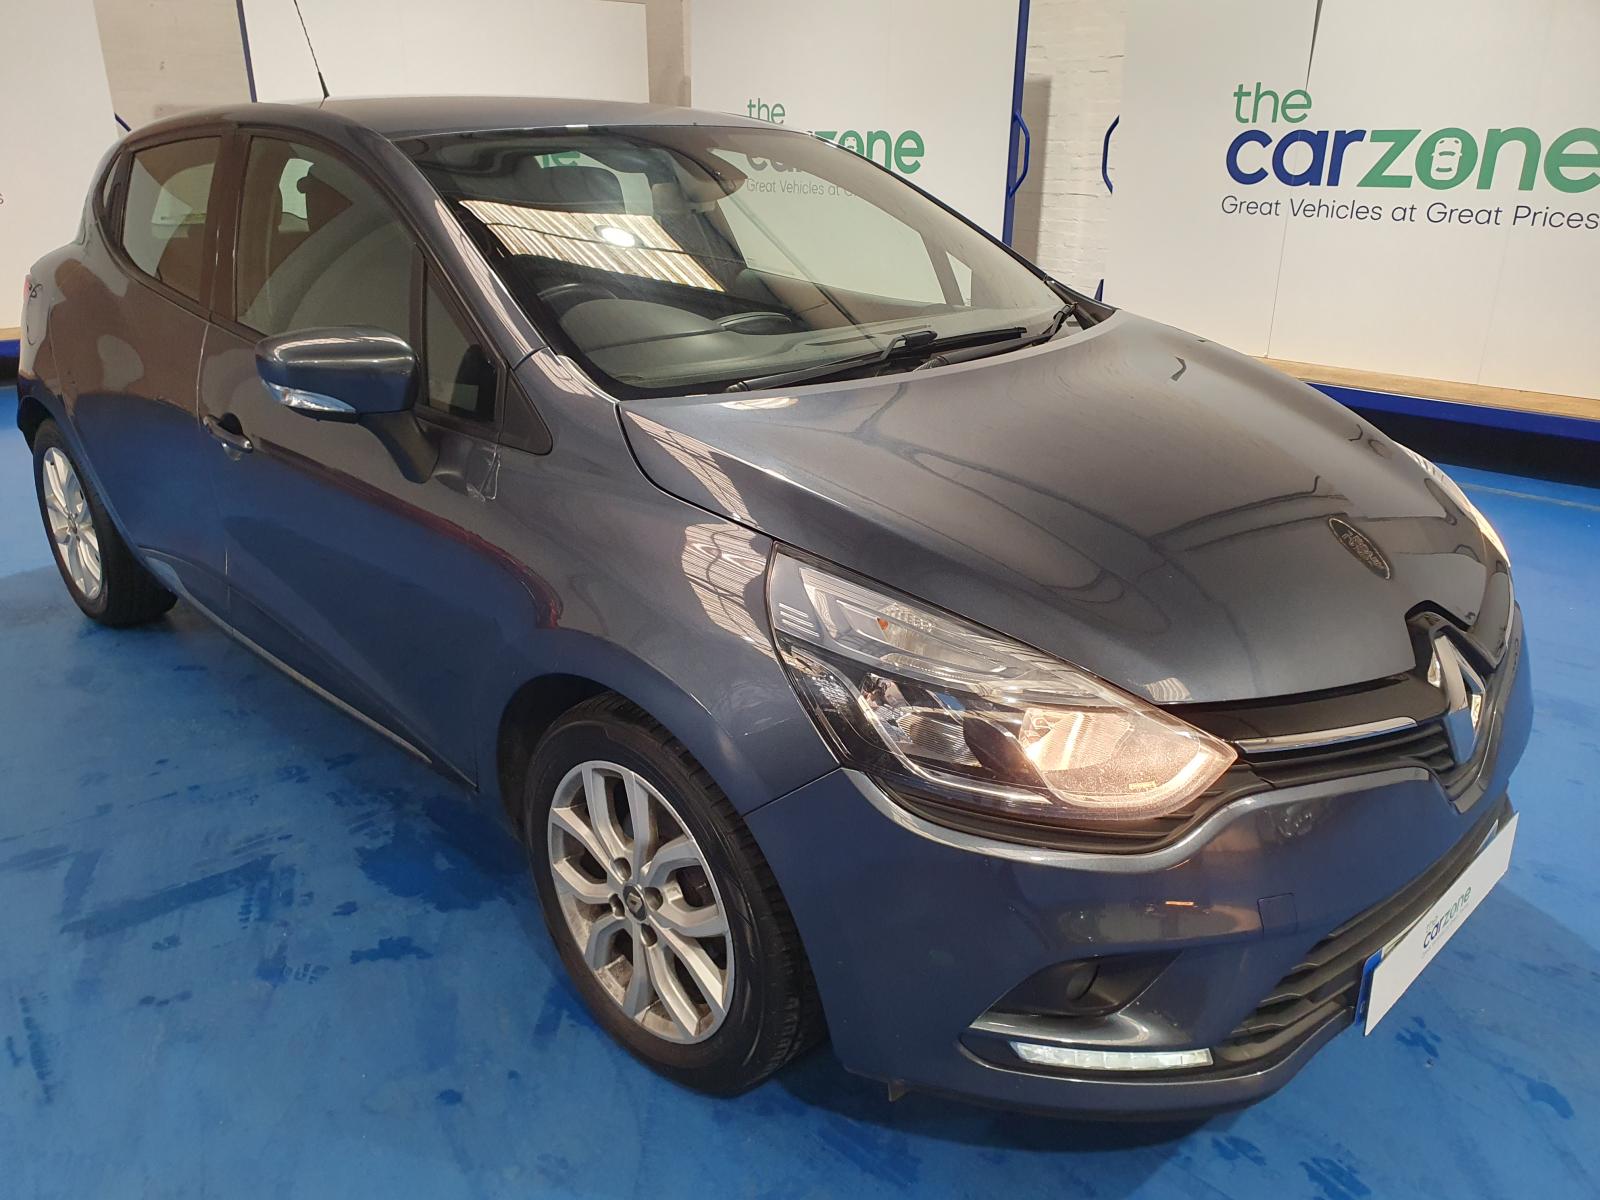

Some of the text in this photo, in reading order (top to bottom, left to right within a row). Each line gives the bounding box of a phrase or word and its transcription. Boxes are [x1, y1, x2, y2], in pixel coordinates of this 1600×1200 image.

[747, 98, 786, 124] the
[1233, 82, 1312, 123] the
[1226, 127, 1600, 193] carzone
[747, 178, 776, 193] Great
[780, 181, 824, 196] Vehicles
[828, 185, 840, 196] at
[1221, 195, 1600, 230] Great Vehicles at Great Prices
[1423, 887, 1471, 948] carzone
